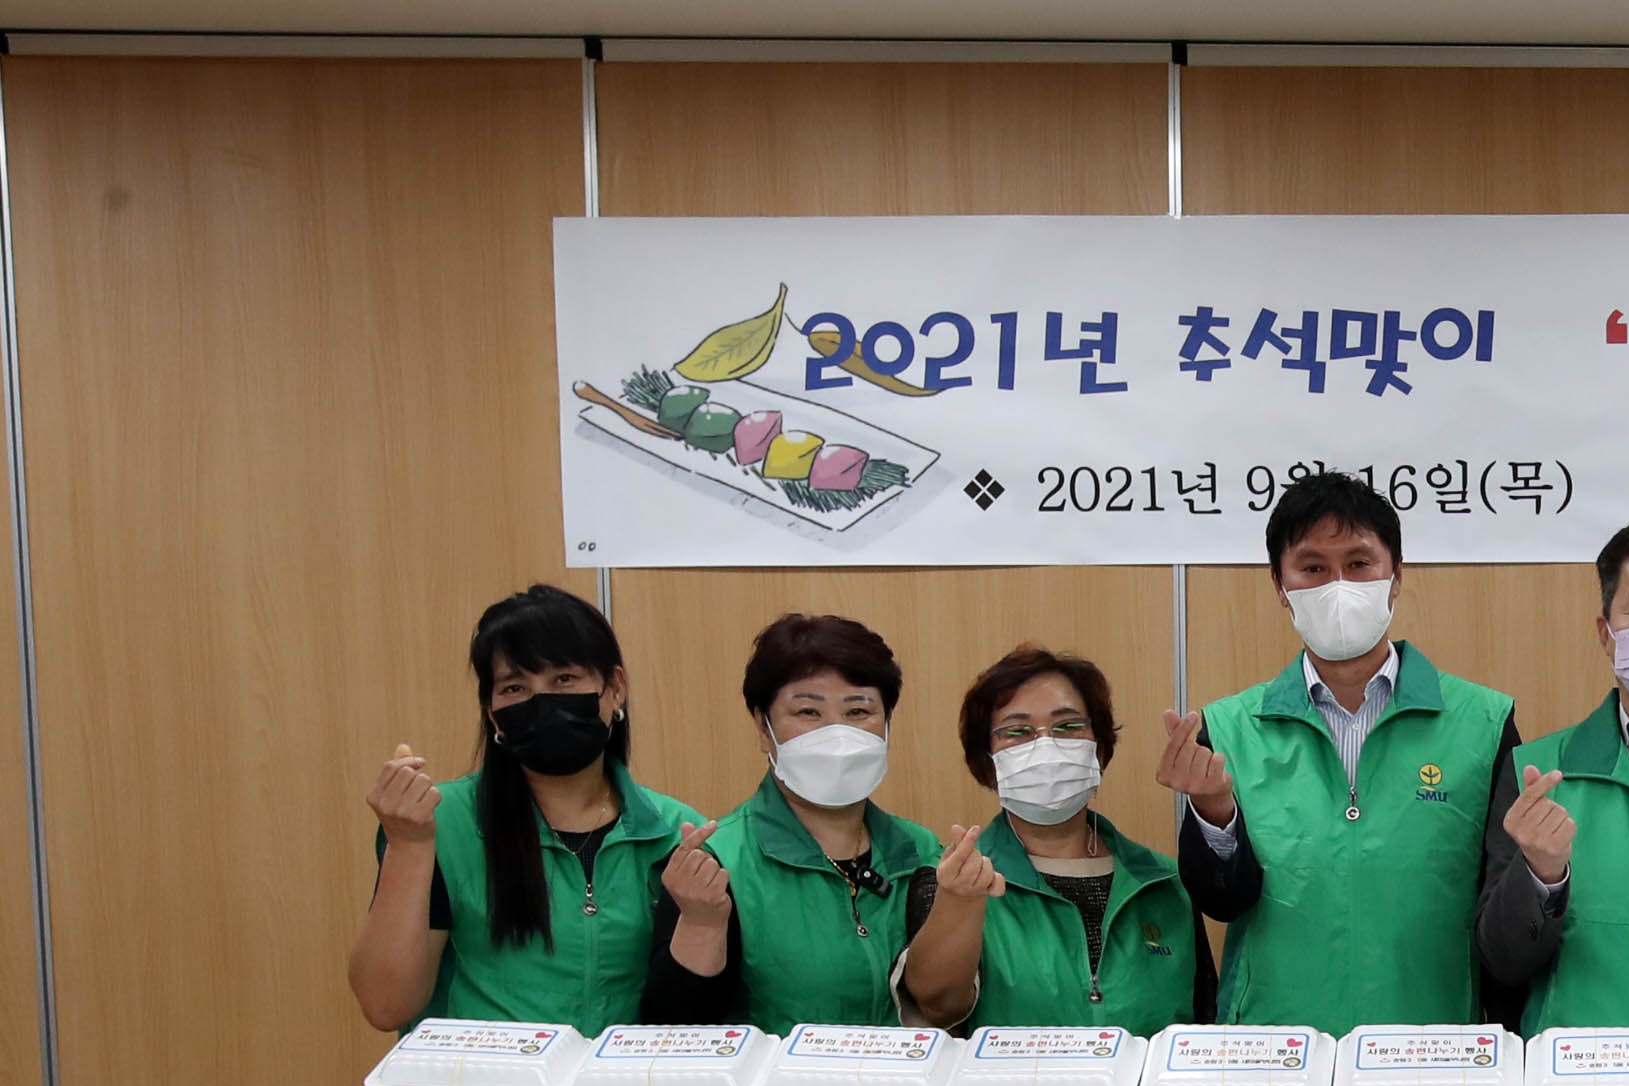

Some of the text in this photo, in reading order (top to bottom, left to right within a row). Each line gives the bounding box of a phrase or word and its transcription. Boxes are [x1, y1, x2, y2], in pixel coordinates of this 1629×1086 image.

[804, 311, 1129, 394] 2021년
[1177, 306, 1495, 397] 추석맞이
[1037, 462, 1221, 515] 2021년
[1359, 459, 1575, 516] 16일(목)
[1415, 790, 1449, 802] SMU
